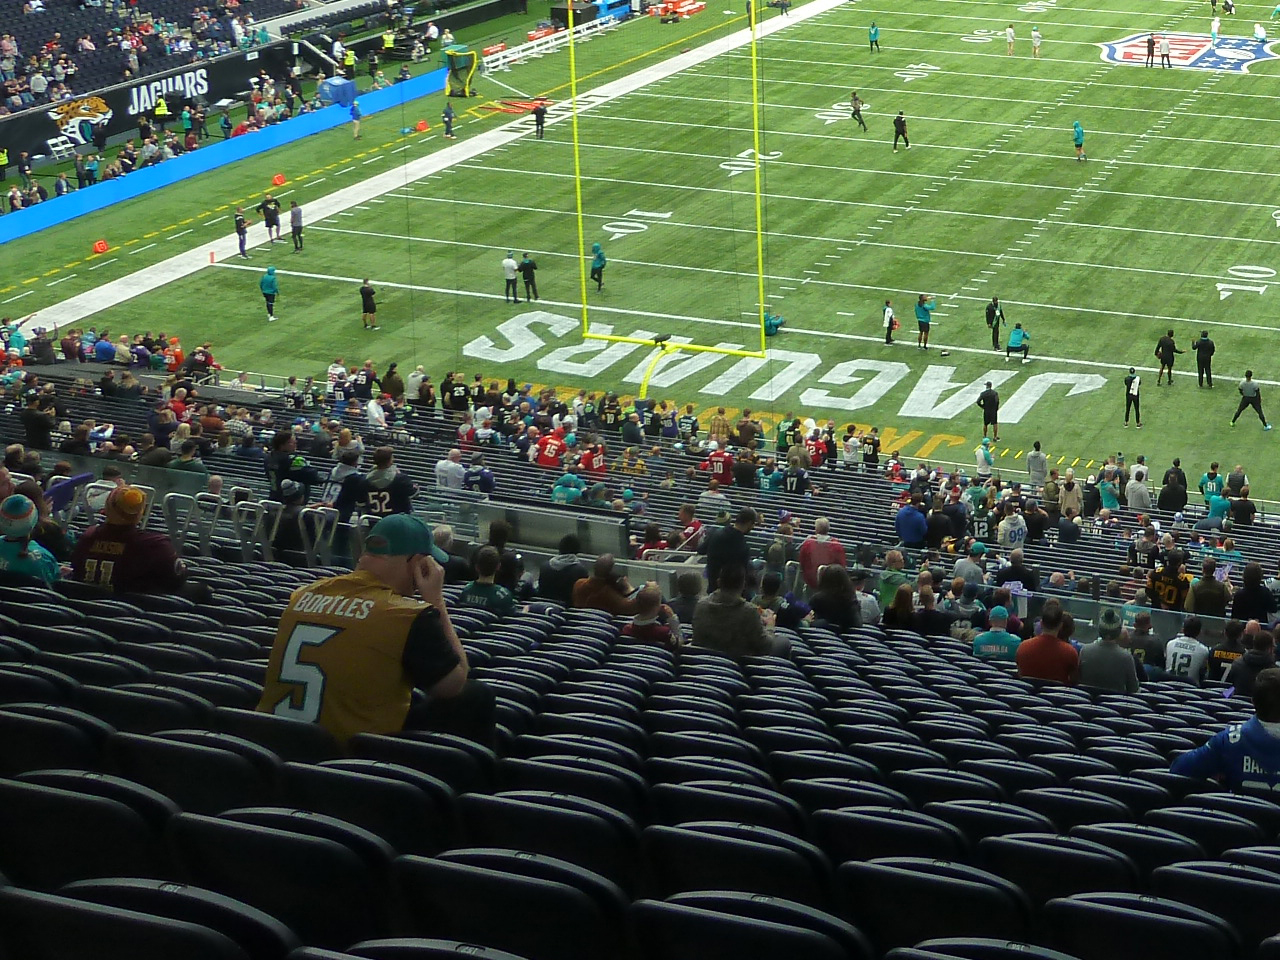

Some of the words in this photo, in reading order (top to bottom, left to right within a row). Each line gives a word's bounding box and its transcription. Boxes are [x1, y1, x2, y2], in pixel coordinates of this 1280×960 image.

[894, 63, 941, 77] 40
[128, 68, 208, 115] JAGUARS
[719, 148, 783, 171] 20
[602, 208, 673, 233] 10
[1215, 265, 1277, 295] 10
[462, 310, 1108, 425] JAGUARS
[453, 387, 466, 396] 25
[543, 445, 556, 458] 15
[713, 462, 723, 474] 10
[786, 477, 798, 491] 17
[1206, 481, 1216, 492] 91
[369, 492, 393, 513] 52
[973, 521, 989, 538] 12
[1009, 528, 1024, 543] 99
[1136, 552, 1148, 564] 15
[84, 558, 115, 589] 11
[293, 592, 375, 620] BORTLES
[466, 594, 488, 606] WENTZ
[273, 622, 344, 724] 5
[1171, 652, 1192, 677] 12
[1220, 661, 1233, 683] 7
